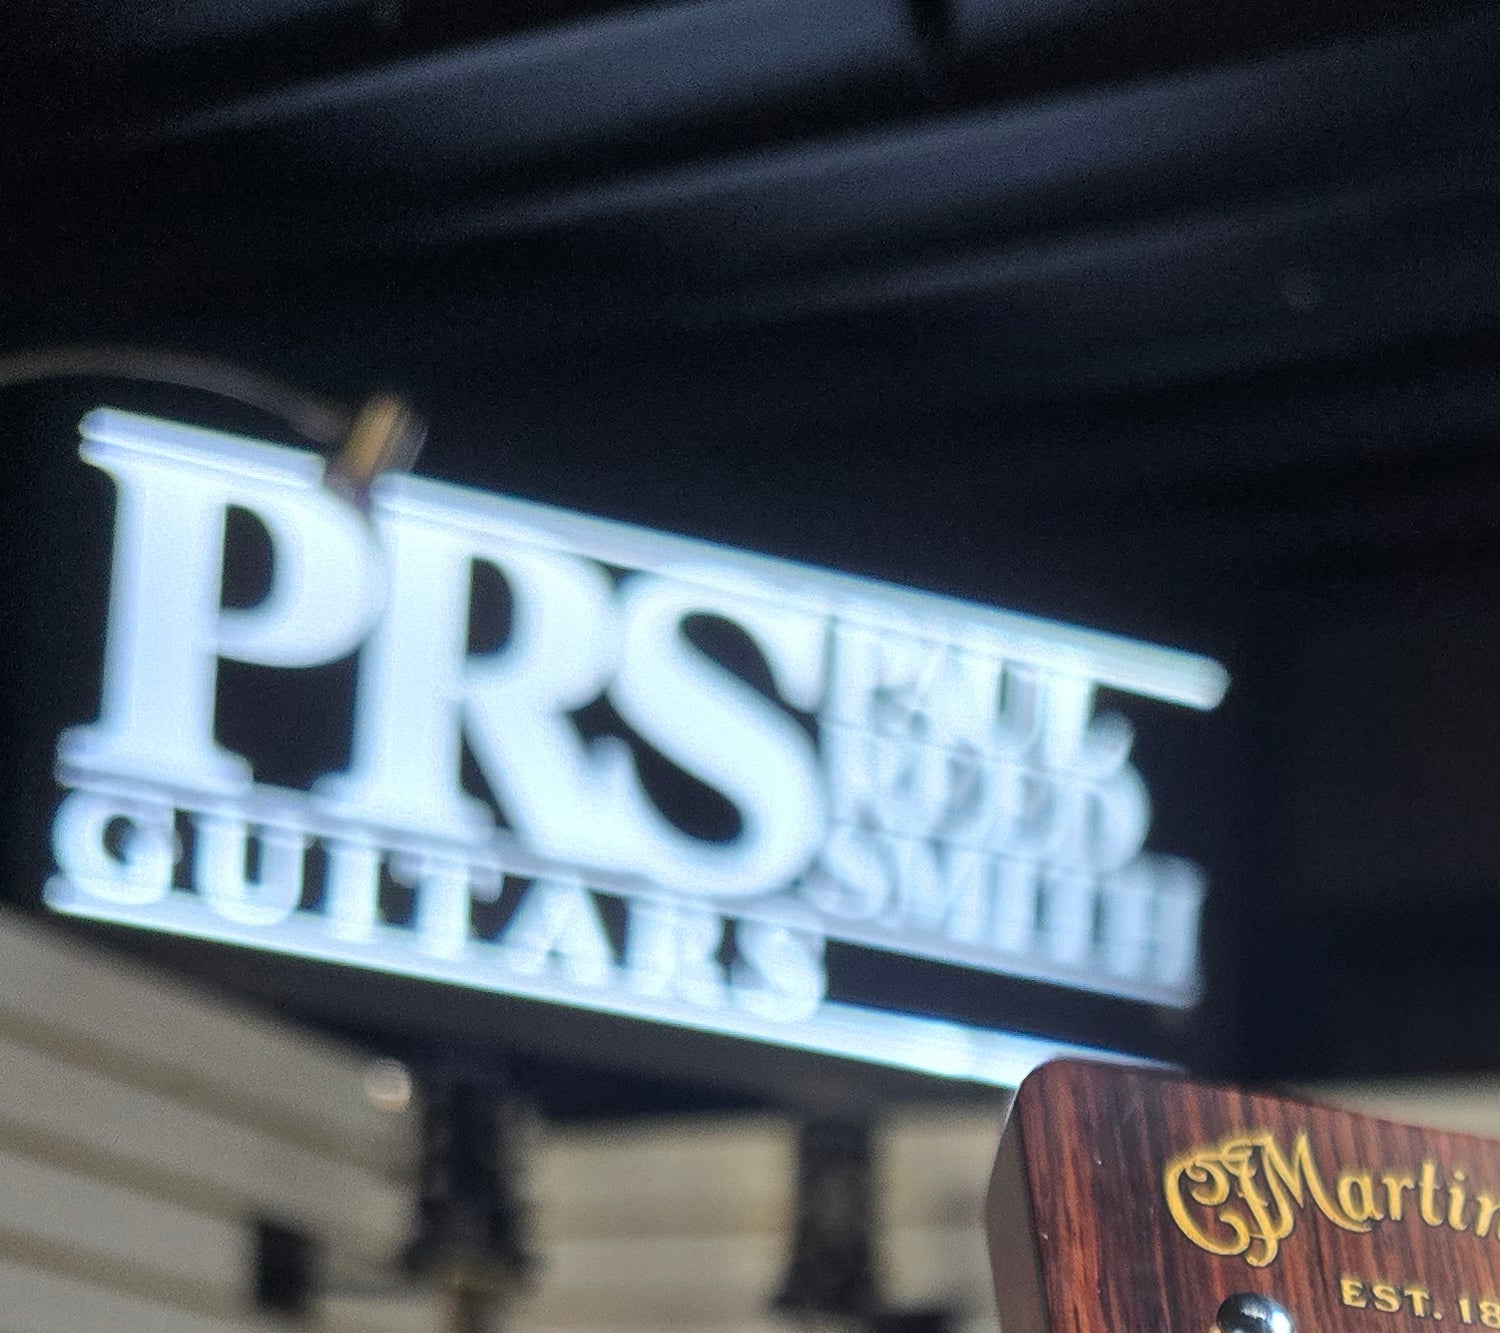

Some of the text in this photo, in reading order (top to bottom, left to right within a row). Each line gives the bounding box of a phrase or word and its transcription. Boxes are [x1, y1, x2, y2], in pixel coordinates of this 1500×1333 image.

[57, 408, 828, 900] PRS
[48, 784, 828, 1024] GUITARS
[1340, 1277, 1443, 1321] EST.
